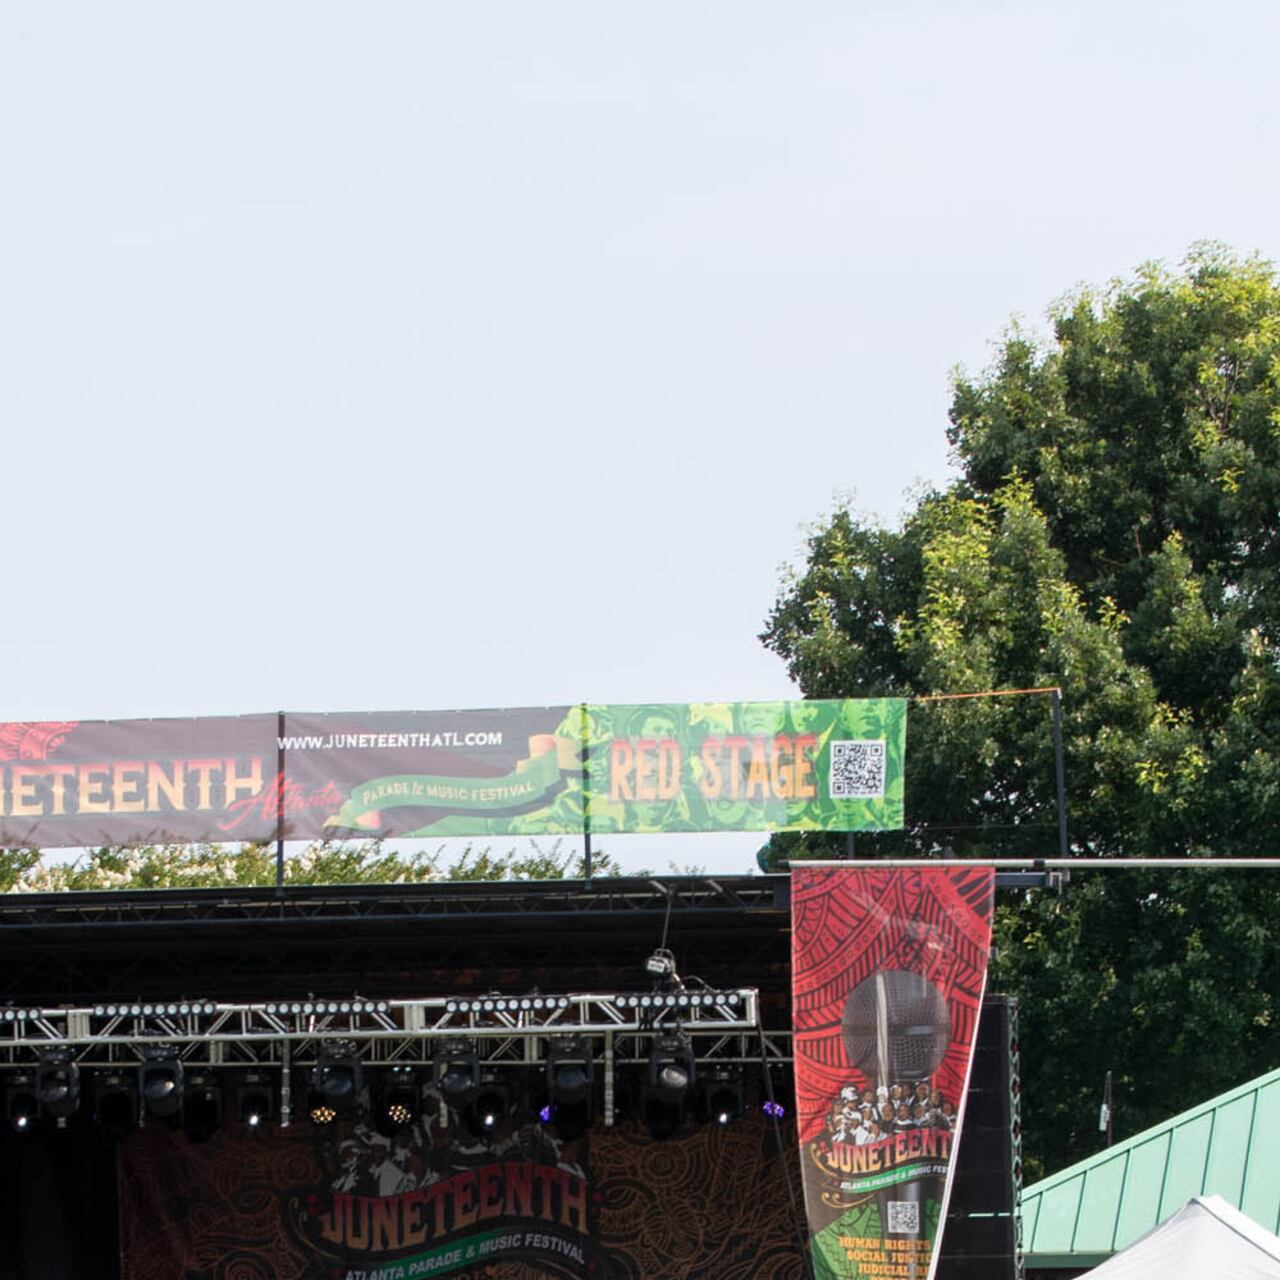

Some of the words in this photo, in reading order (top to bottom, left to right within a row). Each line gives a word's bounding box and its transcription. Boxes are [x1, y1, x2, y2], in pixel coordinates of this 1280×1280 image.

[277, 731, 502, 750] WWW.JUNETEENTHATL.COM
[610, 738, 681, 800] RED
[701, 734, 817, 799] STAGE
[362, 782, 409, 804] PARADE
[427, 784, 468, 799] MUSIC
[472, 781, 534, 800] FESTIVAL
[826, 1128, 950, 1174] JUNETEENT
[322, 1161, 589, 1252] JUNETEENTH
[408, 1250, 462, 1277] PARADE
[466, 1246, 475, 1259] &
[479, 1234, 521, 1255] MUSIC
[524, 1233, 585, 1265] FESTIVAL
[858, 1263, 909, 1275] JUDICIAL
[891, 1253, 932, 1263] JUSTIC
